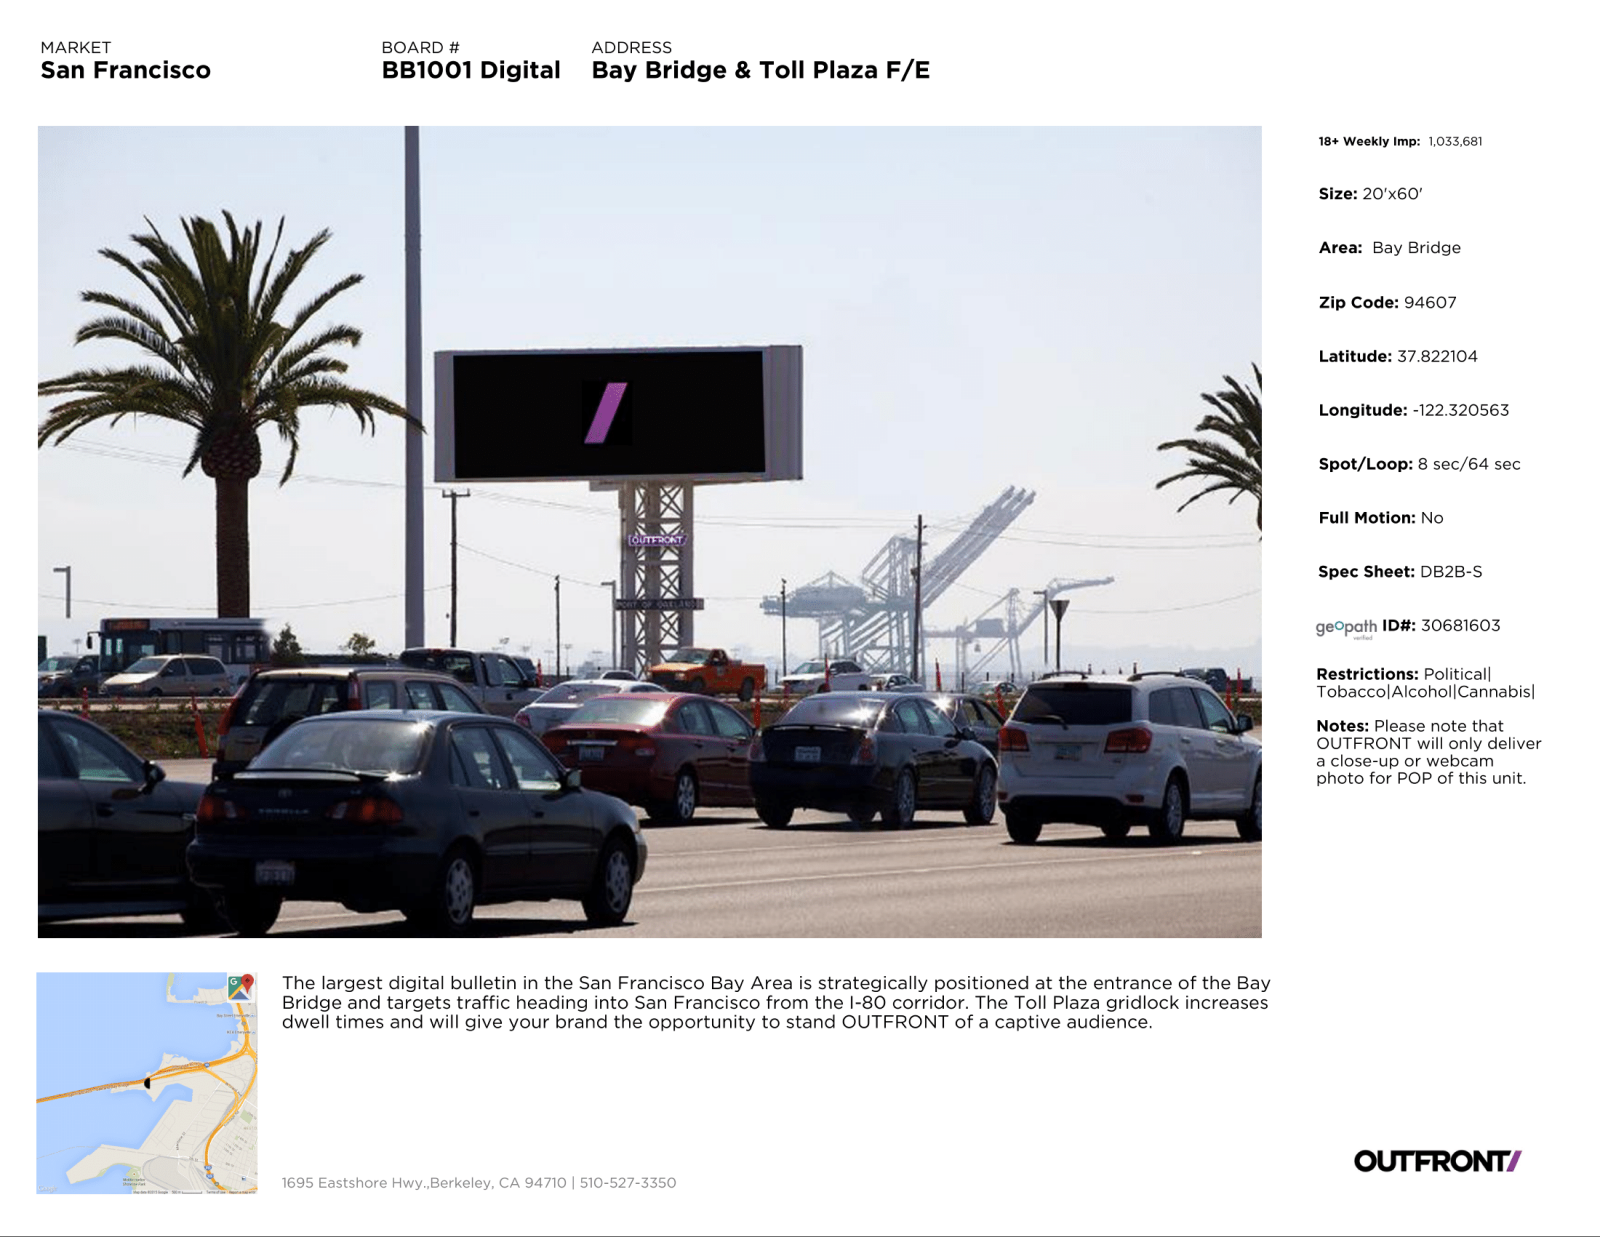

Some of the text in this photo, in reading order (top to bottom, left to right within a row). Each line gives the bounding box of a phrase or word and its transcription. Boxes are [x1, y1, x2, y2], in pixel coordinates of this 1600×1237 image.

[42, 41, 111, 53] MARKET
[383, 41, 460, 54] BOARD #
[592, 41, 672, 54] ADDRESS
[41, 60, 211, 79] San Francisco
[383, 60, 560, 82] BB1001 Digital
[593, 59, 930, 82] Bay Bridge & Toll Plaza F/E
[1319, 136, 1482, 148] 18+ Weekly Imp: 1,033,681
[1319, 187, 1357, 200] Size:
[1319, 241, 1461, 256] Area: Bay Bridge
[1319, 296, 1456, 311] Zip Code: 94607
[1320, 350, 1478, 362] Latitude: 37.822104
[1320, 403, 1509, 418] Longitude: -122.320563
[1319, 456, 1520, 472] Spot/Loop: 8 sec/64 sec
[1320, 511, 1443, 524] Full Motion: No
[1319, 565, 1482, 580] Spec Sheet: DB2B-S
[1316, 619, 1500, 637] geopath ID#: 30681603
[1317, 667, 1418, 680] Restrictions:
[1317, 719, 1504, 732] Notes: Please note that
[1317, 737, 1542, 752] OUTFRONT will only deliver
[1317, 754, 1493, 769] a close-up or webcam
[1317, 771, 1526, 786] photo for POP of this unit.
[282, 976, 1270, 992] The largest digital bulletin in the San Francisco Bay Area is strategically positioned at the entrance of the Bay
[283, 995, 1268, 1012] Bridge and targets traffic heading into San Francisco from the I-80 corridor. The Toll Plaza gridlock increases
[283, 1014, 1152, 1031] dwell times and will give your brand the opportunity to stand OUTFRONT of a captive audience.
[282, 1177, 313, 1188] 1695
[319, 1177, 387, 1188] Eastshore
[499, 1177, 520, 1188] CA
[525, 1177, 566, 1188] 94710
[580, 1177, 676, 1188] 510-527-3350
